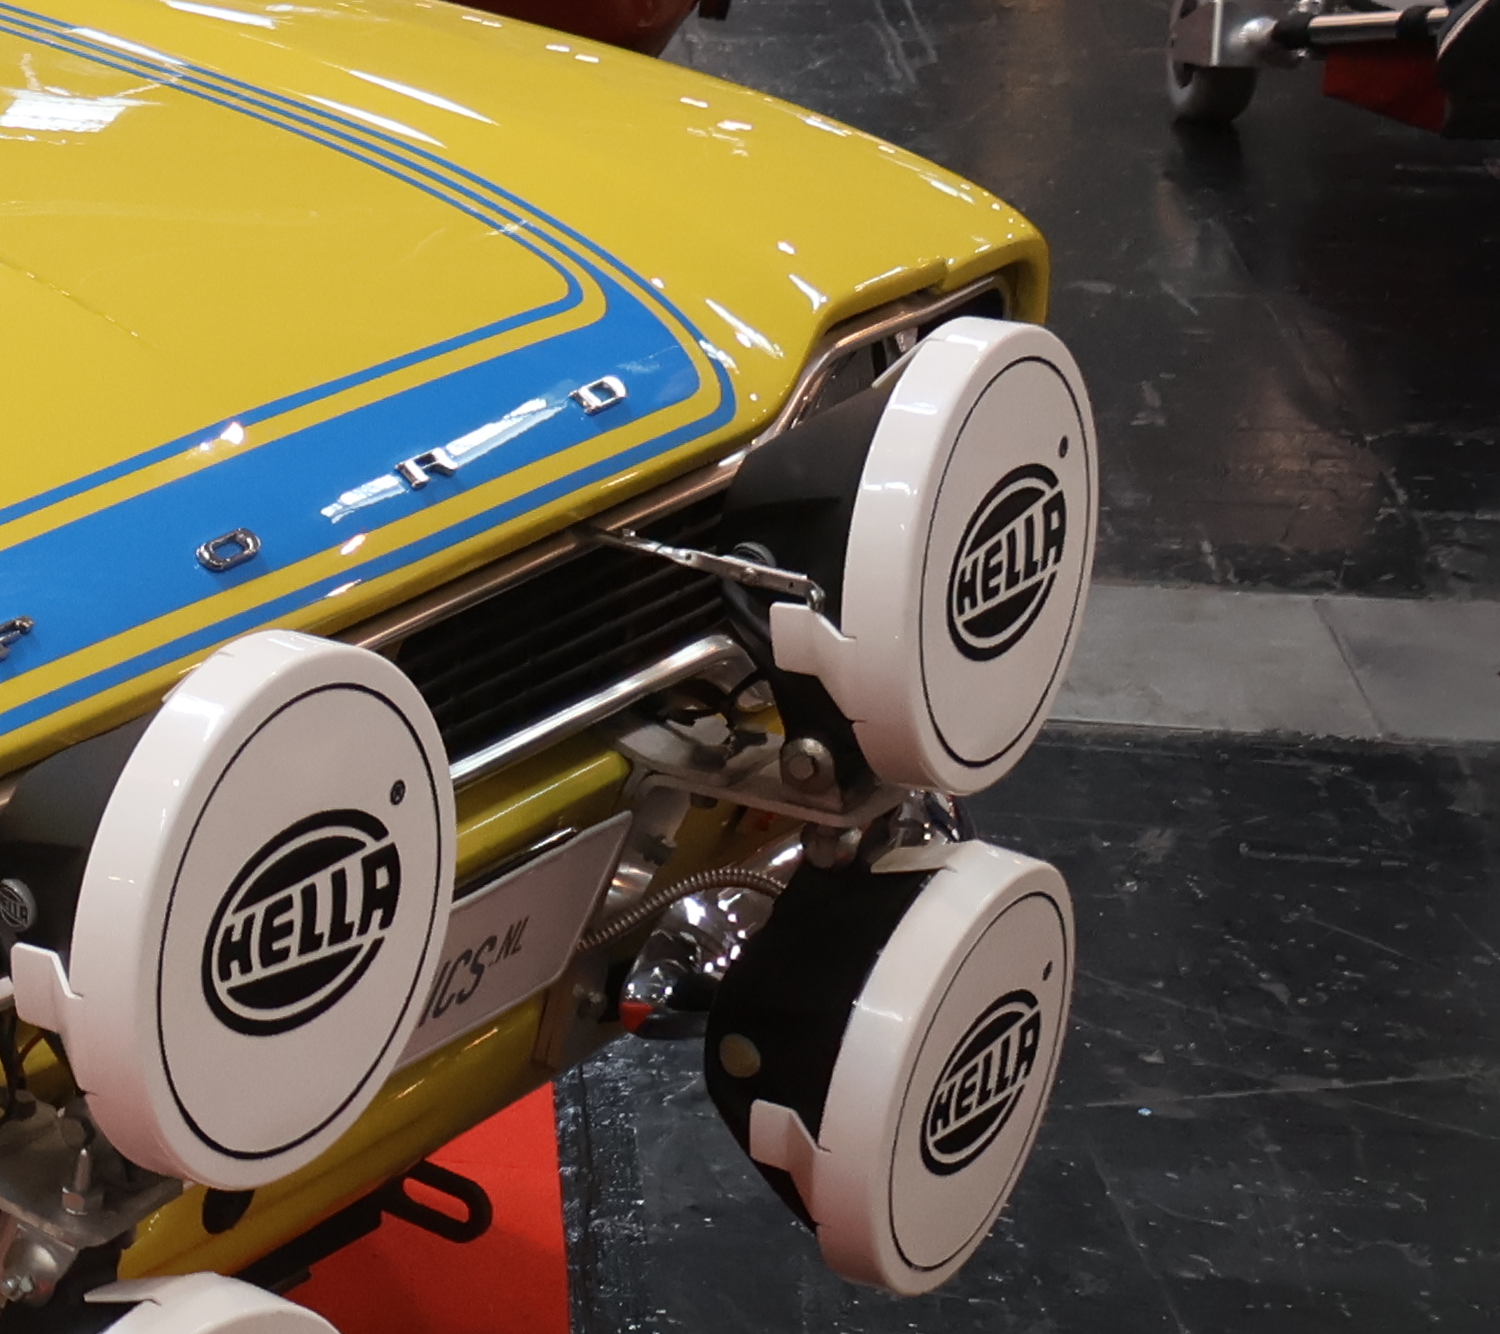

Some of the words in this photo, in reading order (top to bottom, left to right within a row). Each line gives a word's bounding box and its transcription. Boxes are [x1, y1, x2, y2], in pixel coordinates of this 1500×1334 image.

[955, 488, 1068, 618] HELLA
[217, 839, 402, 985] HELLA
[929, 1009, 1042, 1139] HELLA
